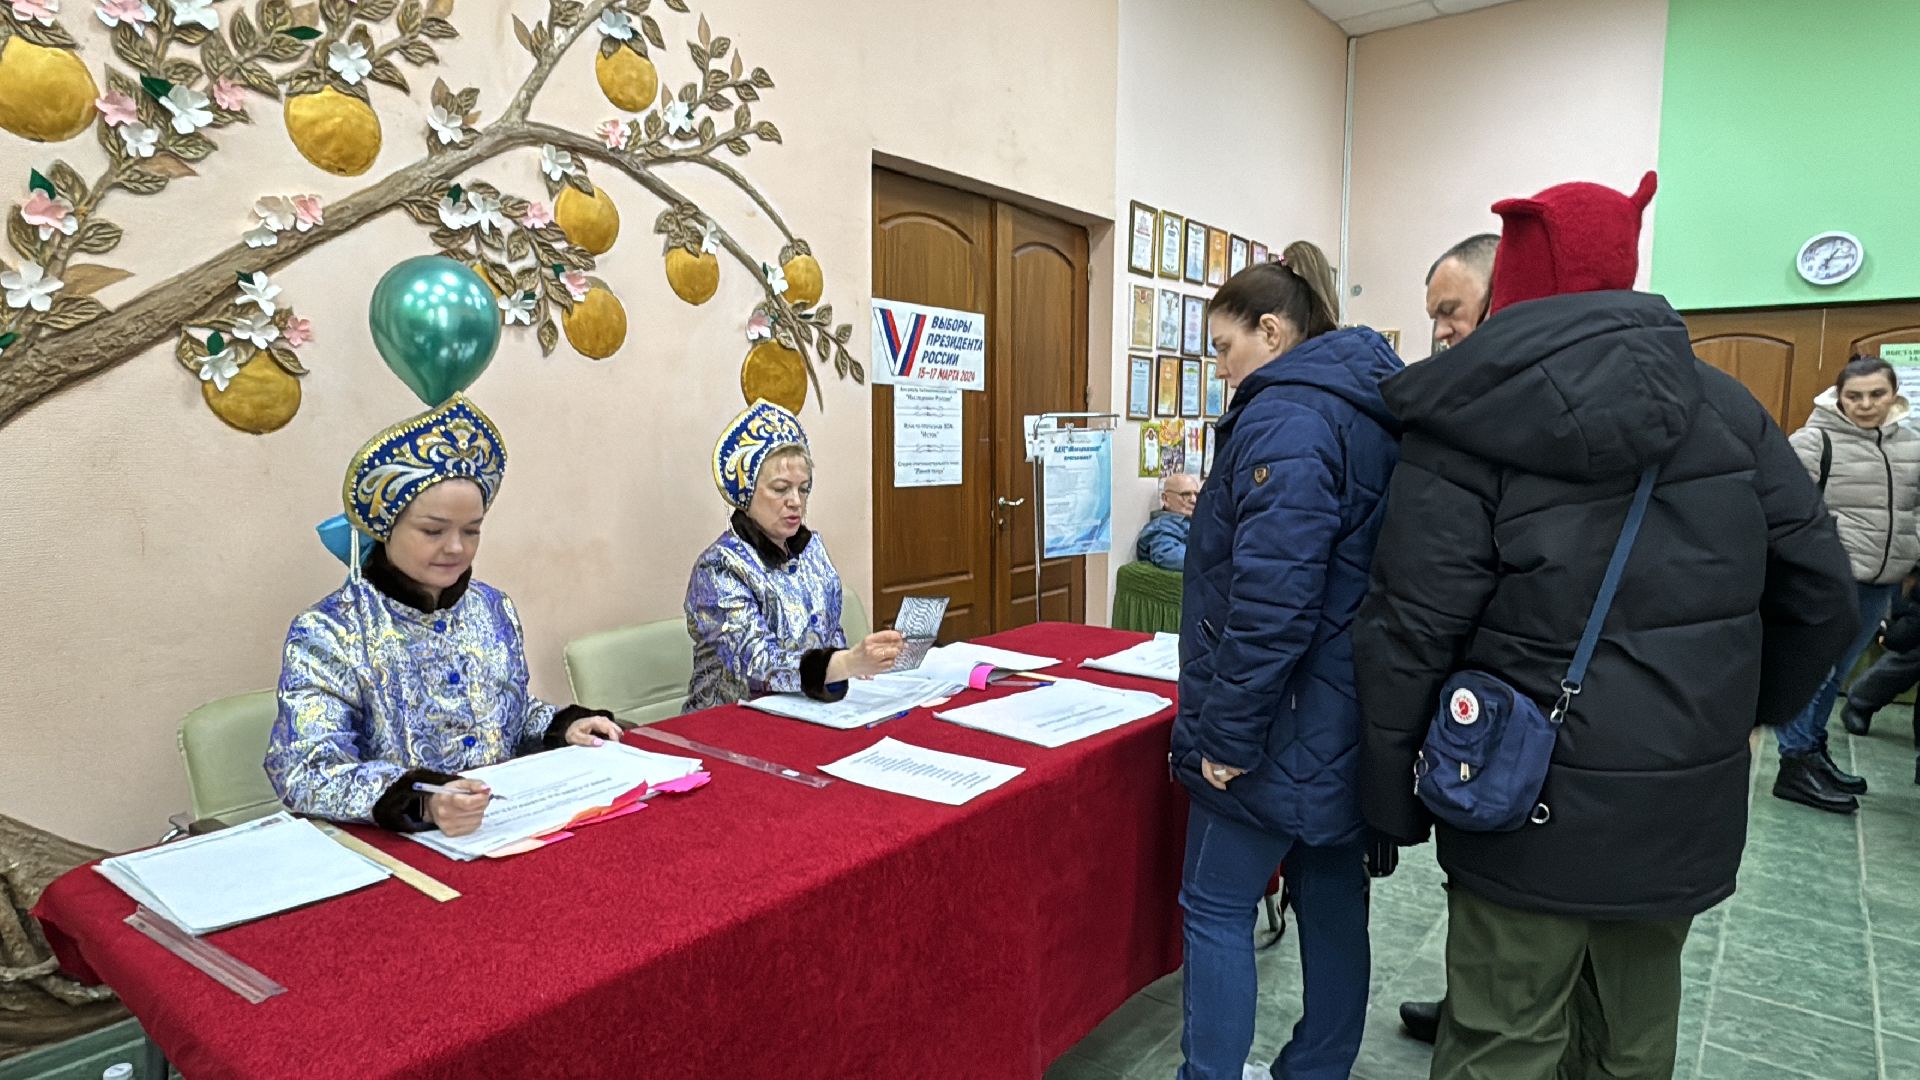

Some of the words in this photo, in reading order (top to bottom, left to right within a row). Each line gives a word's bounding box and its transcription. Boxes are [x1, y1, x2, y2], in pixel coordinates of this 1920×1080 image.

[931, 315, 973, 333] ВЫБОРЫ
[926, 333, 983, 352] ПРЕЗИДЕНТА
[921, 350, 960, 366] РОССИИ
[937, 368, 959, 380] МАРТА
[960, 370, 976, 382] 2024
